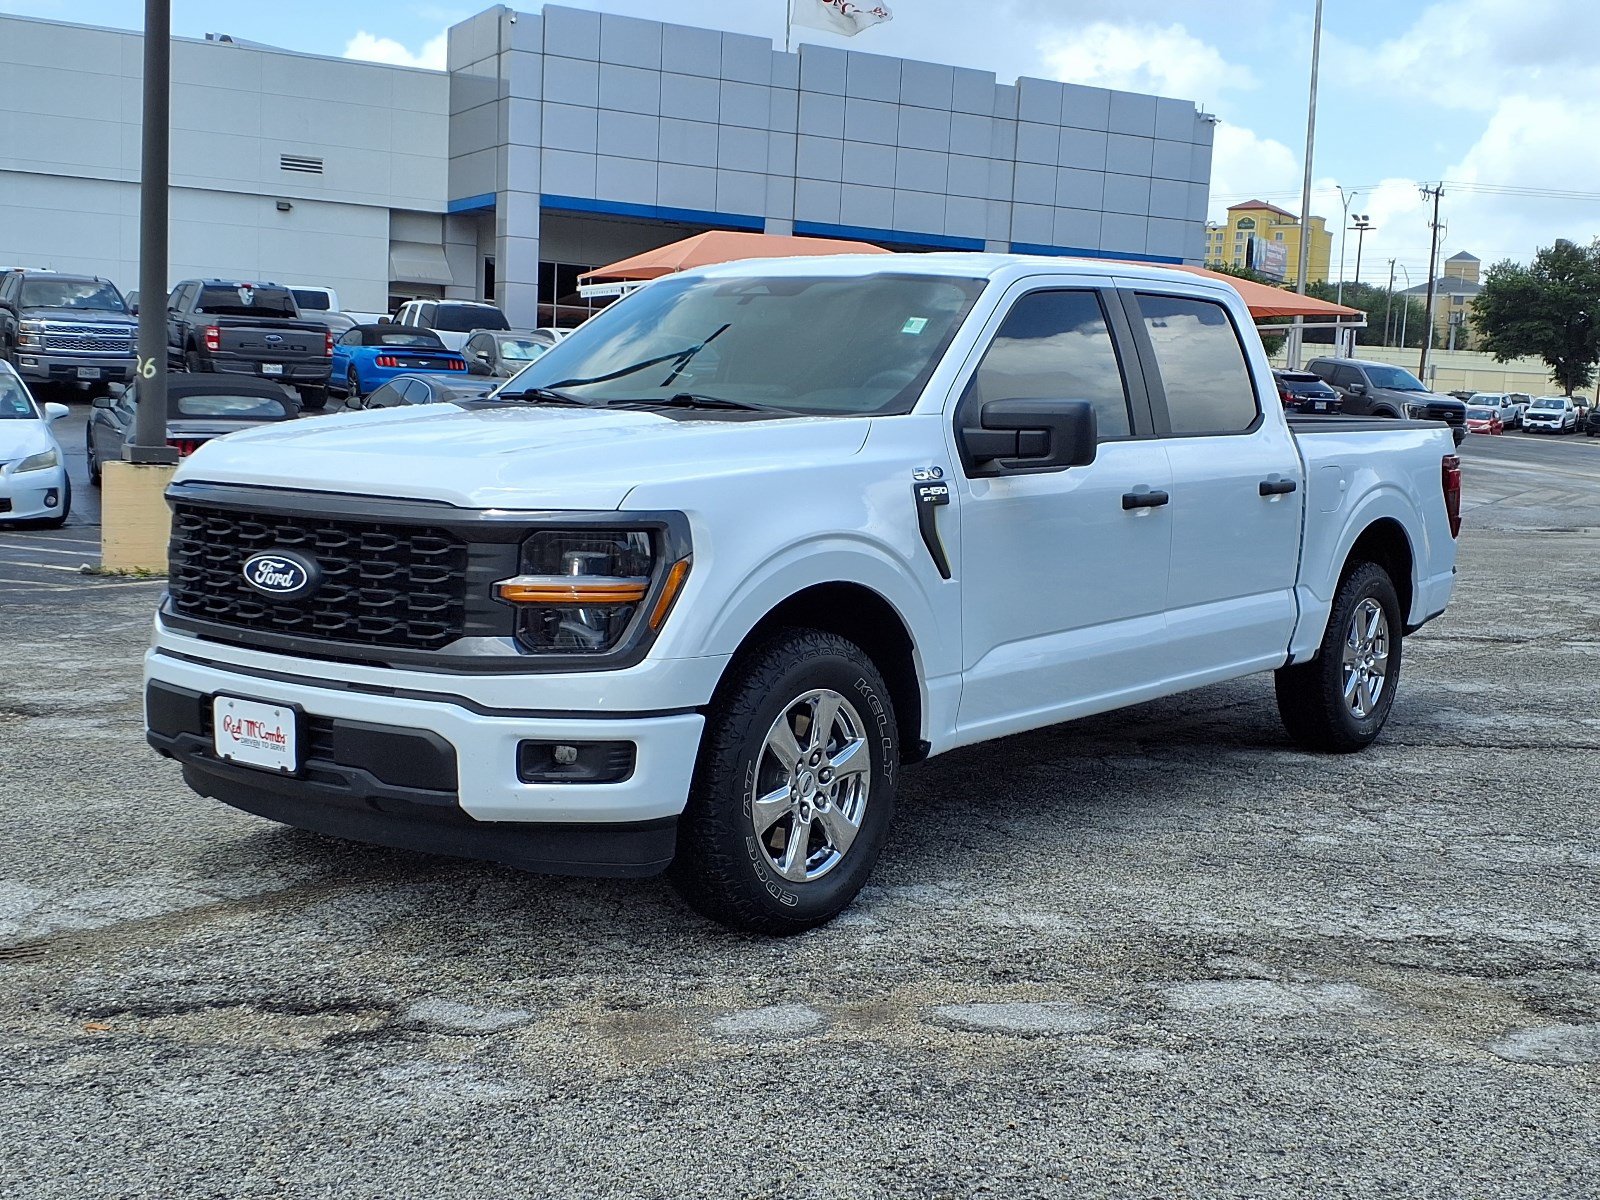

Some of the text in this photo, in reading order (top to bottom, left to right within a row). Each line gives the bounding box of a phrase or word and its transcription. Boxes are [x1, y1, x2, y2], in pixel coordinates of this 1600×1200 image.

[239, 342, 307, 352] F-150
[919, 486, 948, 496] F-150
[254, 560, 294, 587] Ford
[223, 714, 287, 745] Red McCombs
[853, 677, 893, 786] KELLY
[241, 738, 286, 753] DRIVEN TO SERVE
[745, 836, 799, 907] EDGE
